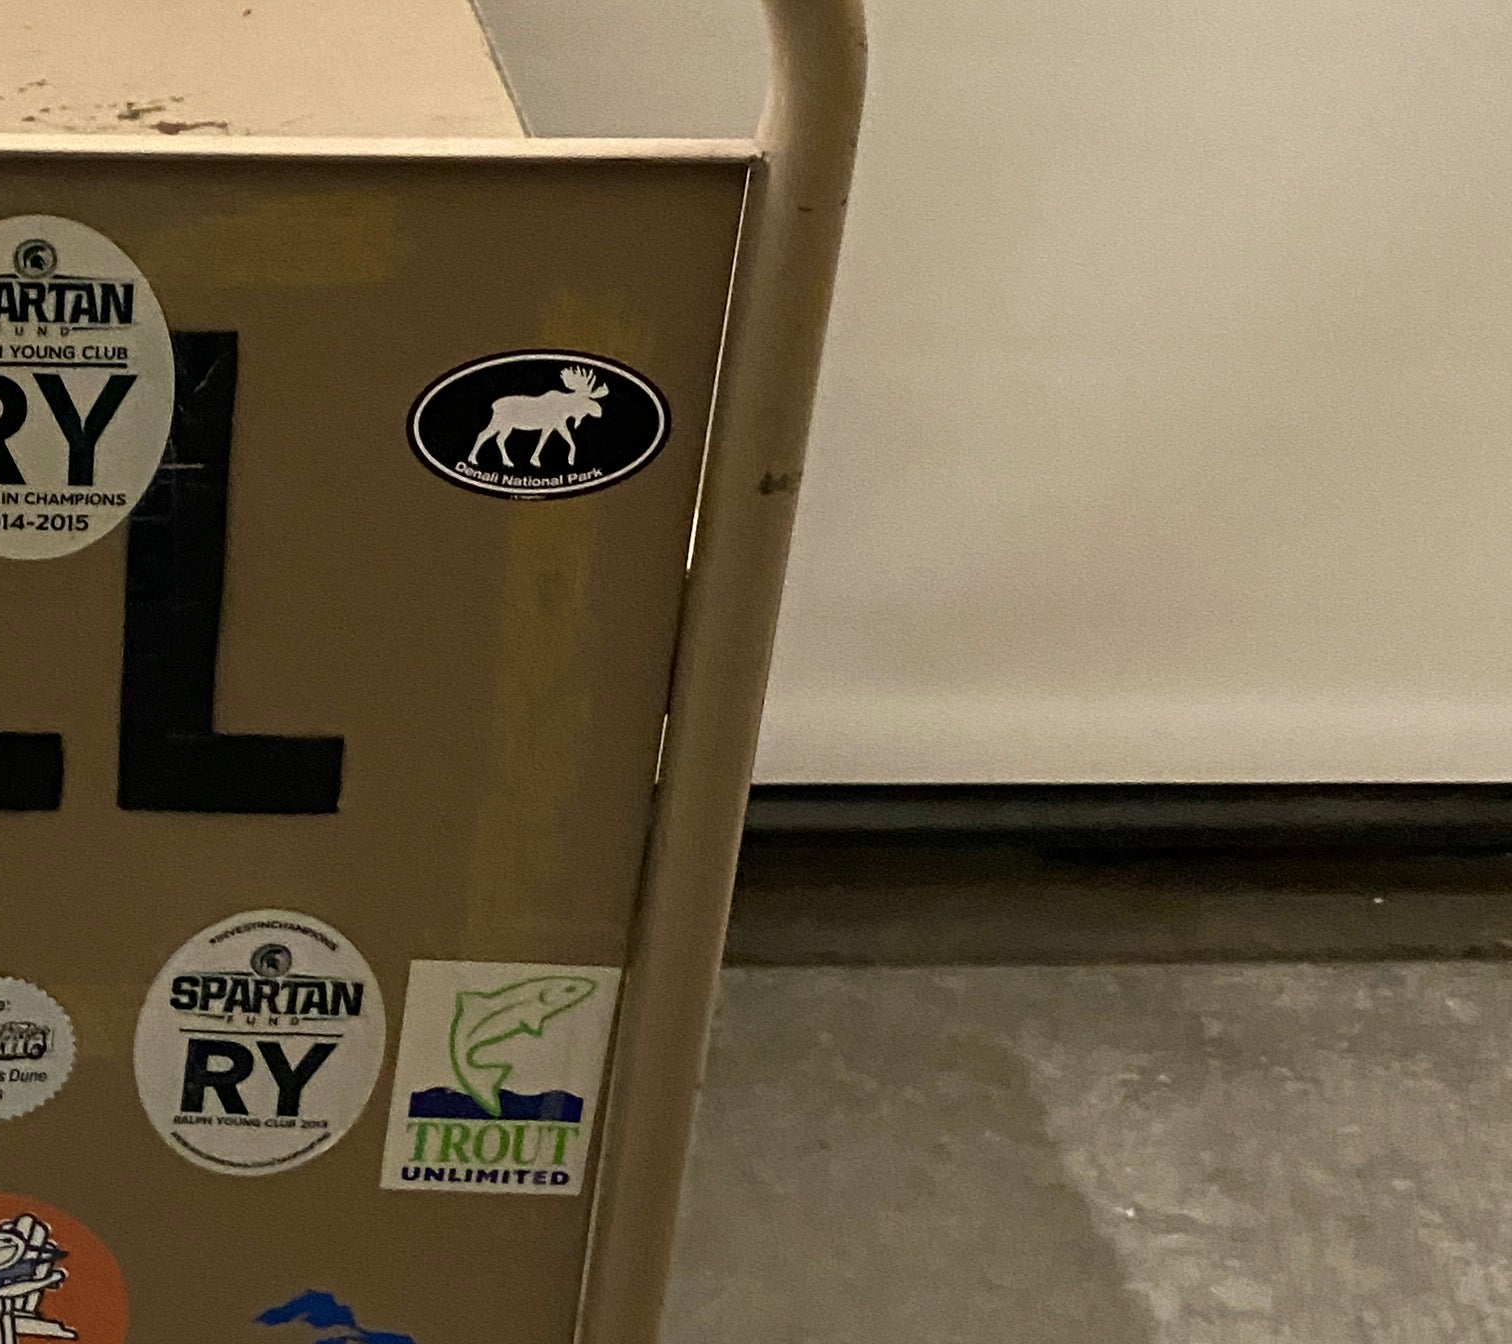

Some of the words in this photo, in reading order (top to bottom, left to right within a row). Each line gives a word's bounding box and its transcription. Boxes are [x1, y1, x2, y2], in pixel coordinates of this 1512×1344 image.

[10, 345, 75, 360] YOUNG
[82, 346, 128, 360] CLUB
[454, 461, 499, 484] Denali
[501, 474, 564, 487] National
[567, 467, 603, 485] Park
[2, 493, 19, 504] IN
[24, 492, 127, 507] CHAMPIONS
[169, 975, 364, 1016] SPARTAN
[8, 1068, 47, 1083] Dune
[180, 1038, 338, 1117] RY
[173, 1115, 212, 1126] RALPH
[217, 1117, 261, 1128] YOUNG
[264, 1118, 296, 1128] CLUB
[407, 1123, 580, 1166] TROUT
[401, 1166, 570, 1186] UNLIMITED
